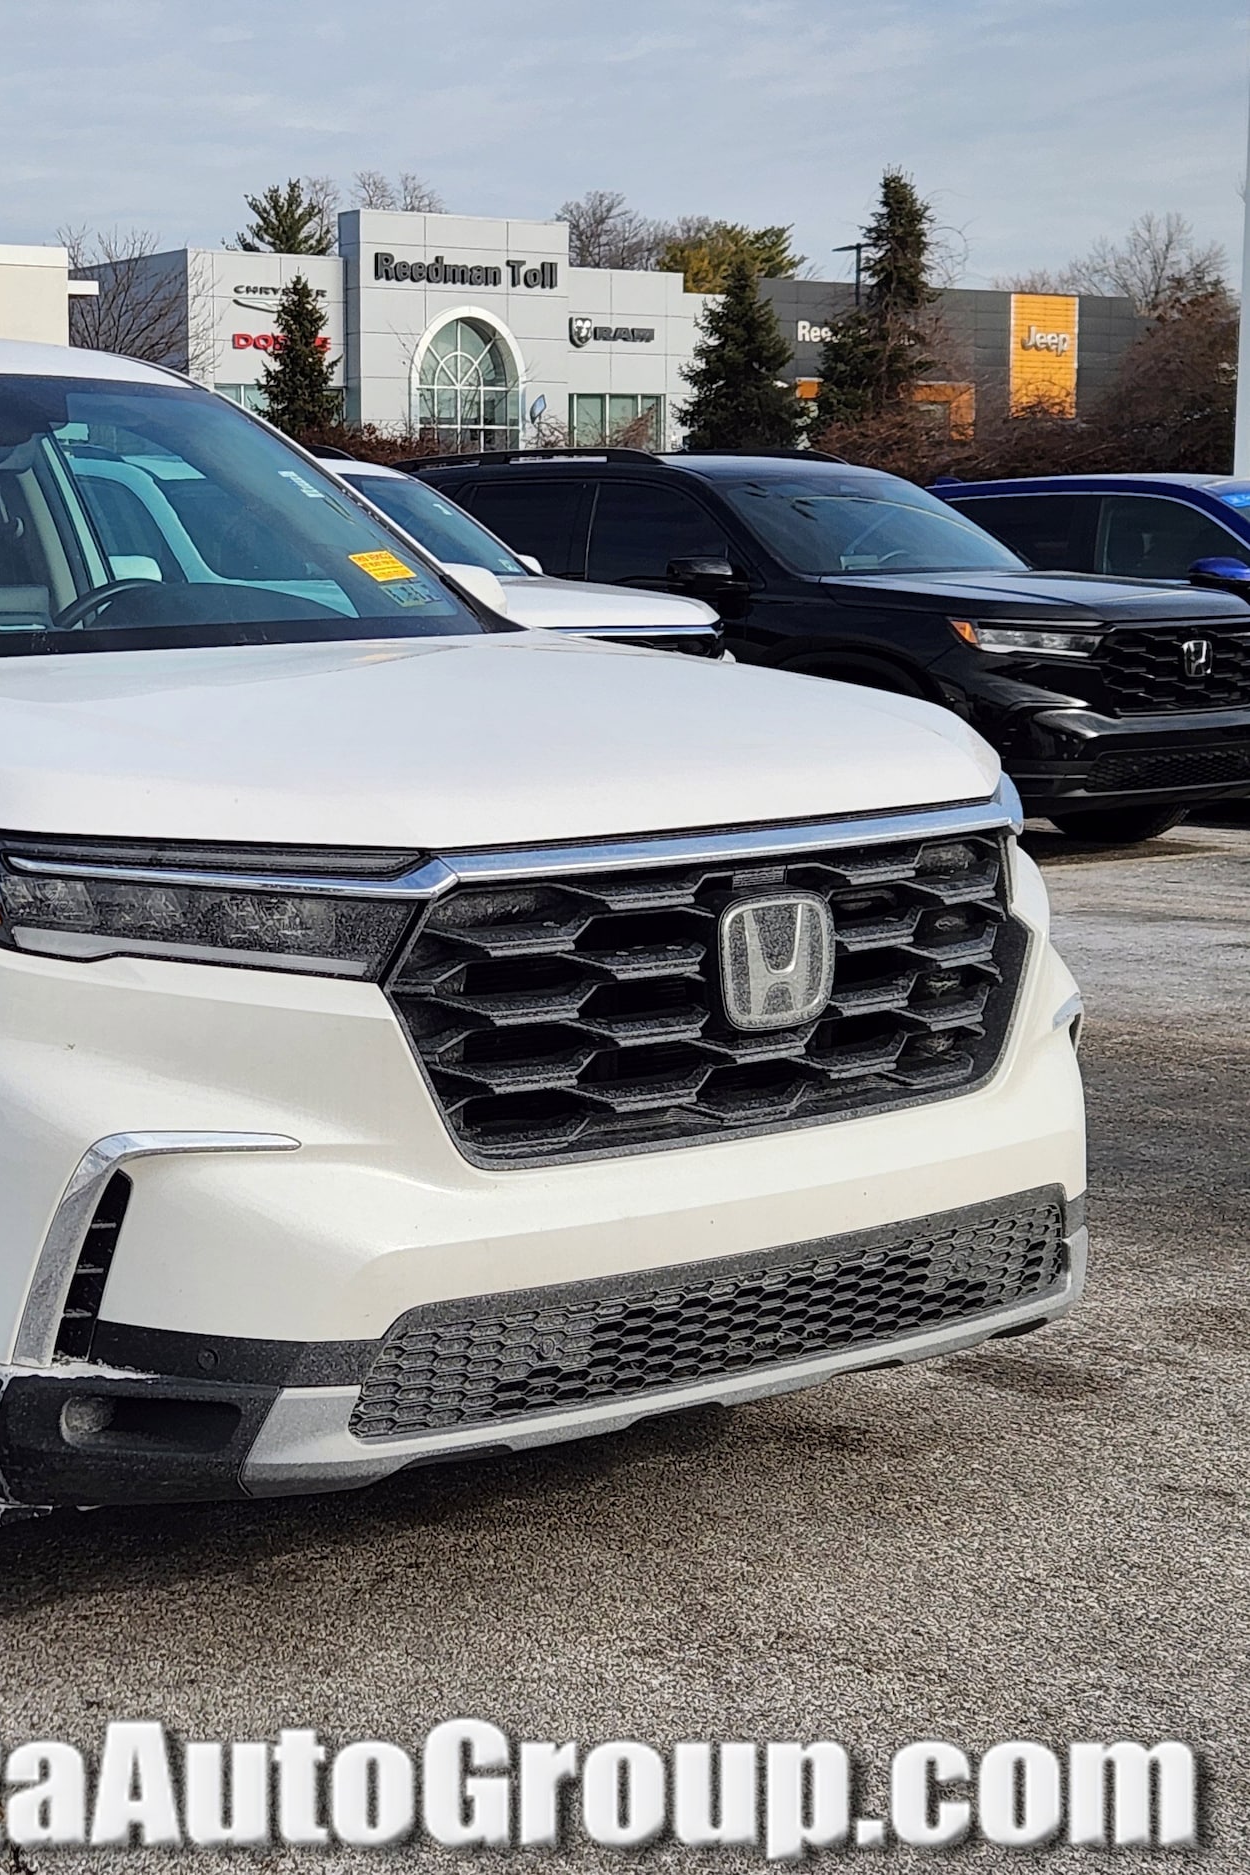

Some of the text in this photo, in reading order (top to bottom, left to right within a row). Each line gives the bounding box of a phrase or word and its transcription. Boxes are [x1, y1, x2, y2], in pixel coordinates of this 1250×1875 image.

[374, 252, 559, 290] Reedman Toll
[233, 285, 328, 298] CHRYSR
[232, 333, 332, 351] DOE
[593, 326, 655, 343] RAM
[1021, 325, 1070, 357] Jeep
